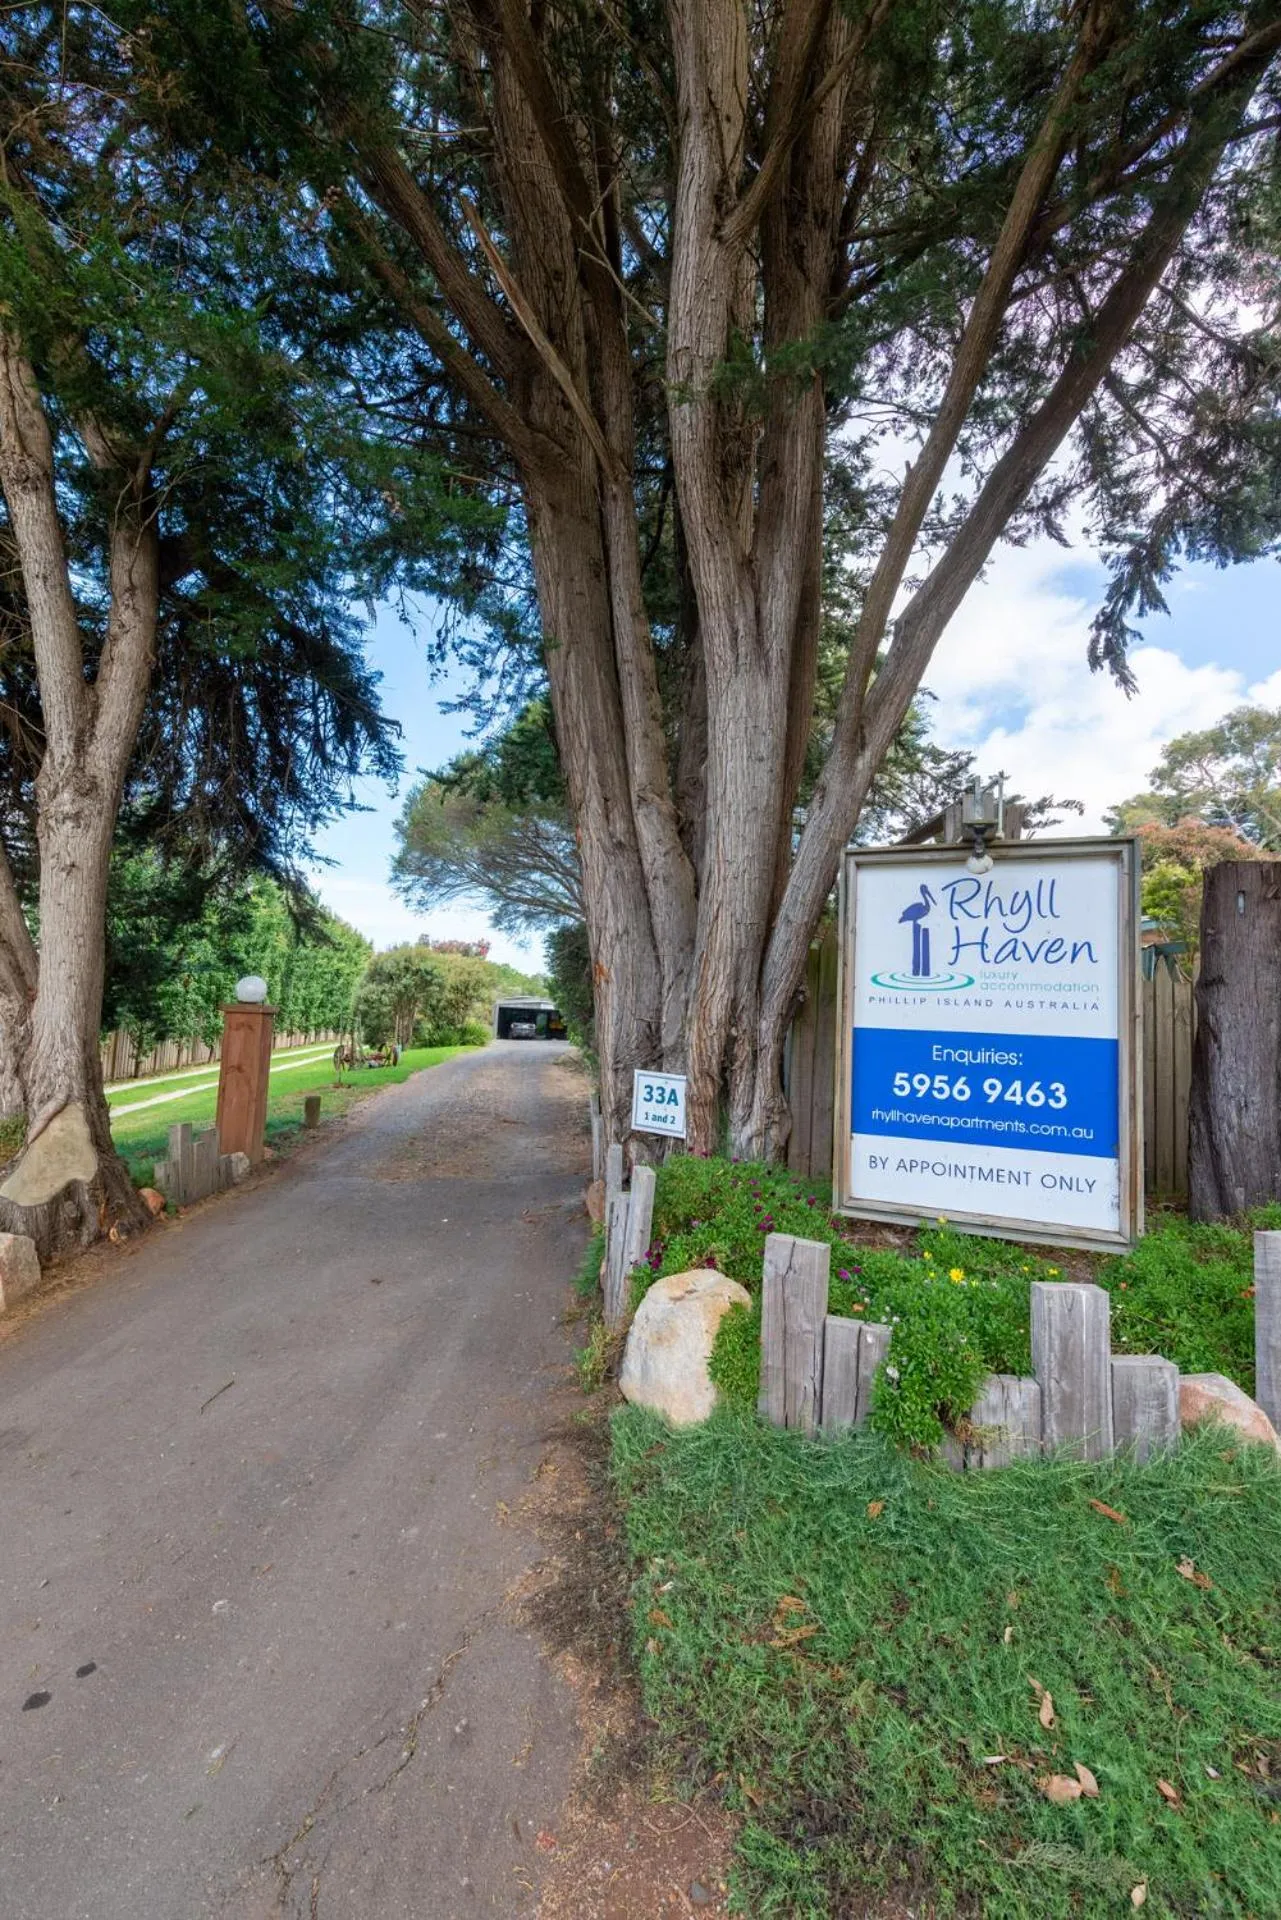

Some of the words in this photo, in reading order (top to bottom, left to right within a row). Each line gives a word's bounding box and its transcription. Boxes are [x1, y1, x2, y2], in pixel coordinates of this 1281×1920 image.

[941, 877, 1061, 934] Rhyll
[947, 925, 1099, 966] Haven
[979, 970, 1018, 982] luxury
[979, 980, 1100, 994] accommodation
[868, 996, 927, 1005] PHILLIP
[936, 998, 994, 1008] ISLAND
[1004, 1000, 1100, 1011] AUSTRALIA
[932, 1044, 1024, 1067] Enquiries:
[643, 1084, 679, 1107] 33A
[892, 1071, 972, 1102] 5956
[982, 1078, 1068, 1110] 9463
[644, 1111, 650, 1121] 1
[651, 1113, 669, 1124] and
[669, 1115, 676, 1125] 2
[871, 1108, 1095, 1140] rhyllhavenapartments.com.au
[868, 1155, 889, 1171] BY
[895, 1158, 1033, 1187] APPOINTMENT
[1040, 1172, 1098, 1194] ONLY
